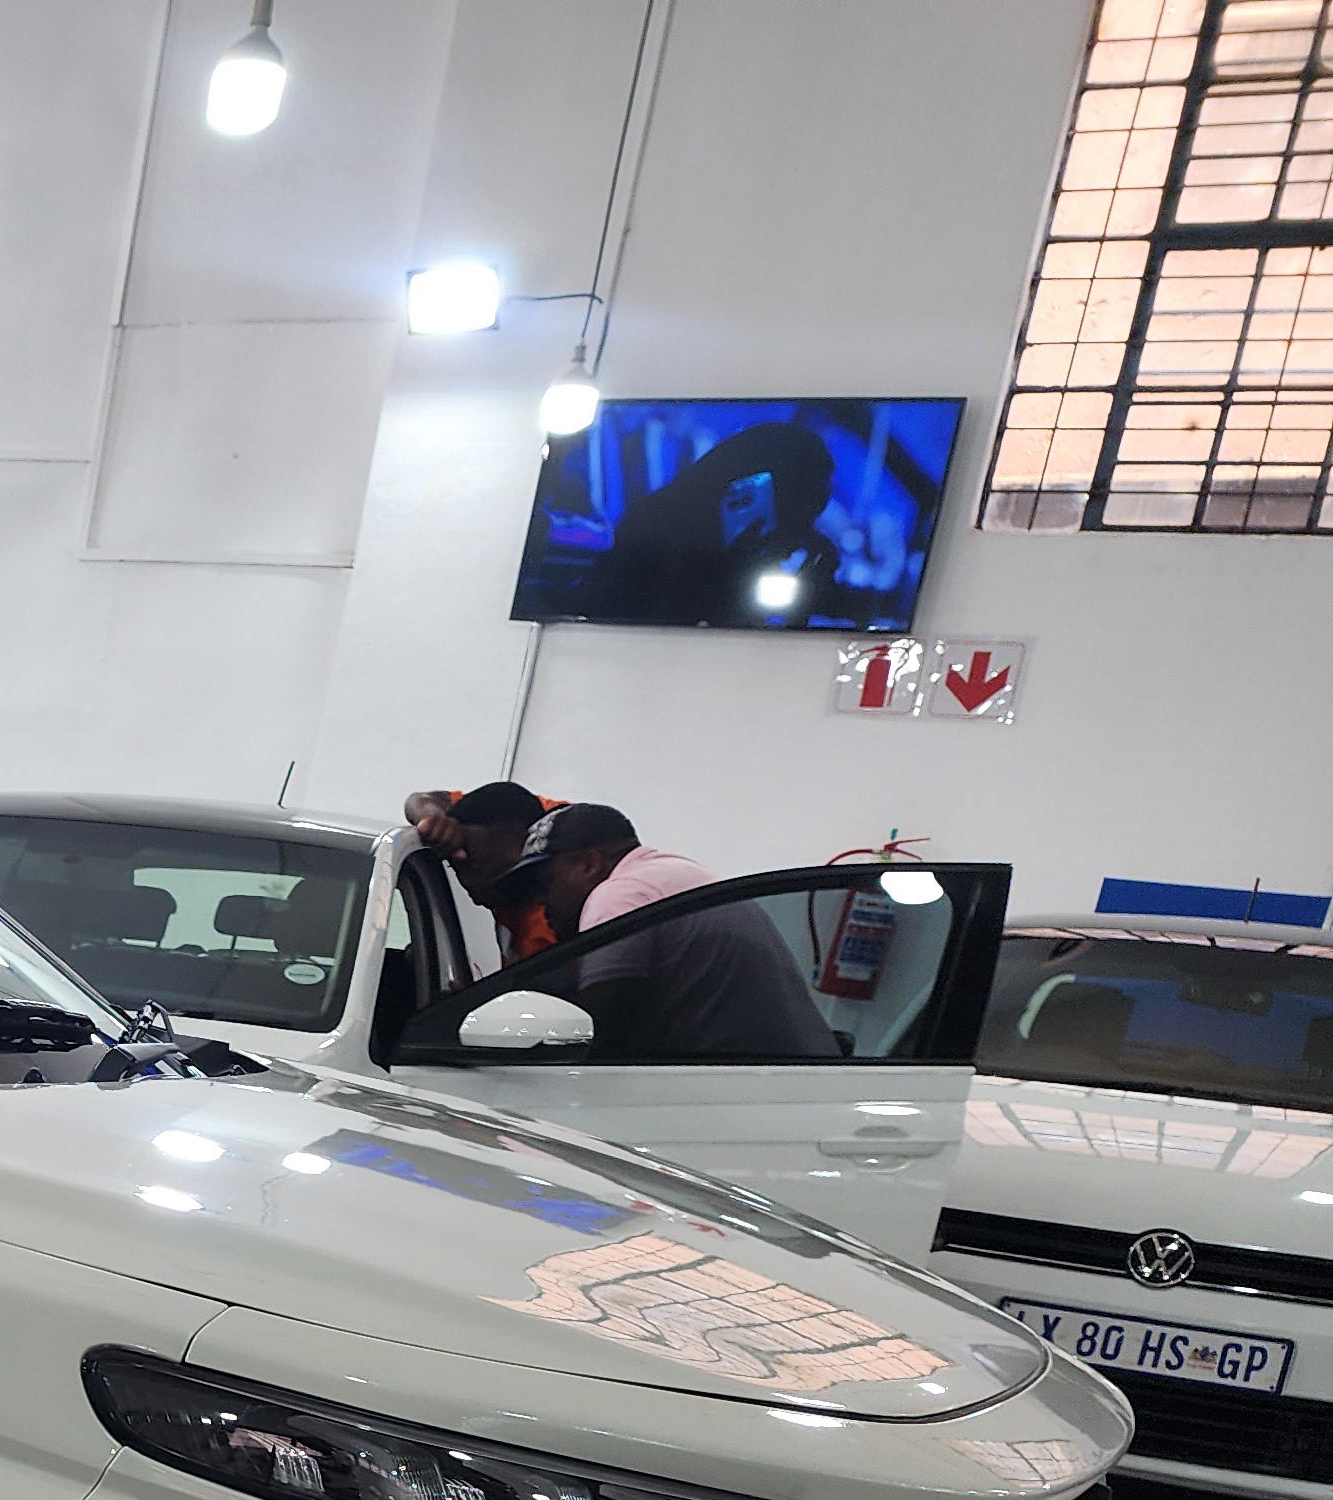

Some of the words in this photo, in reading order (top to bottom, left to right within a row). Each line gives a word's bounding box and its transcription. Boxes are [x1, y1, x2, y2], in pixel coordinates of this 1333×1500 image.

[1076, 1322, 1125, 1361] 80
[1137, 1329, 1190, 1371] HS
[1216, 1342, 1269, 1382] GP
